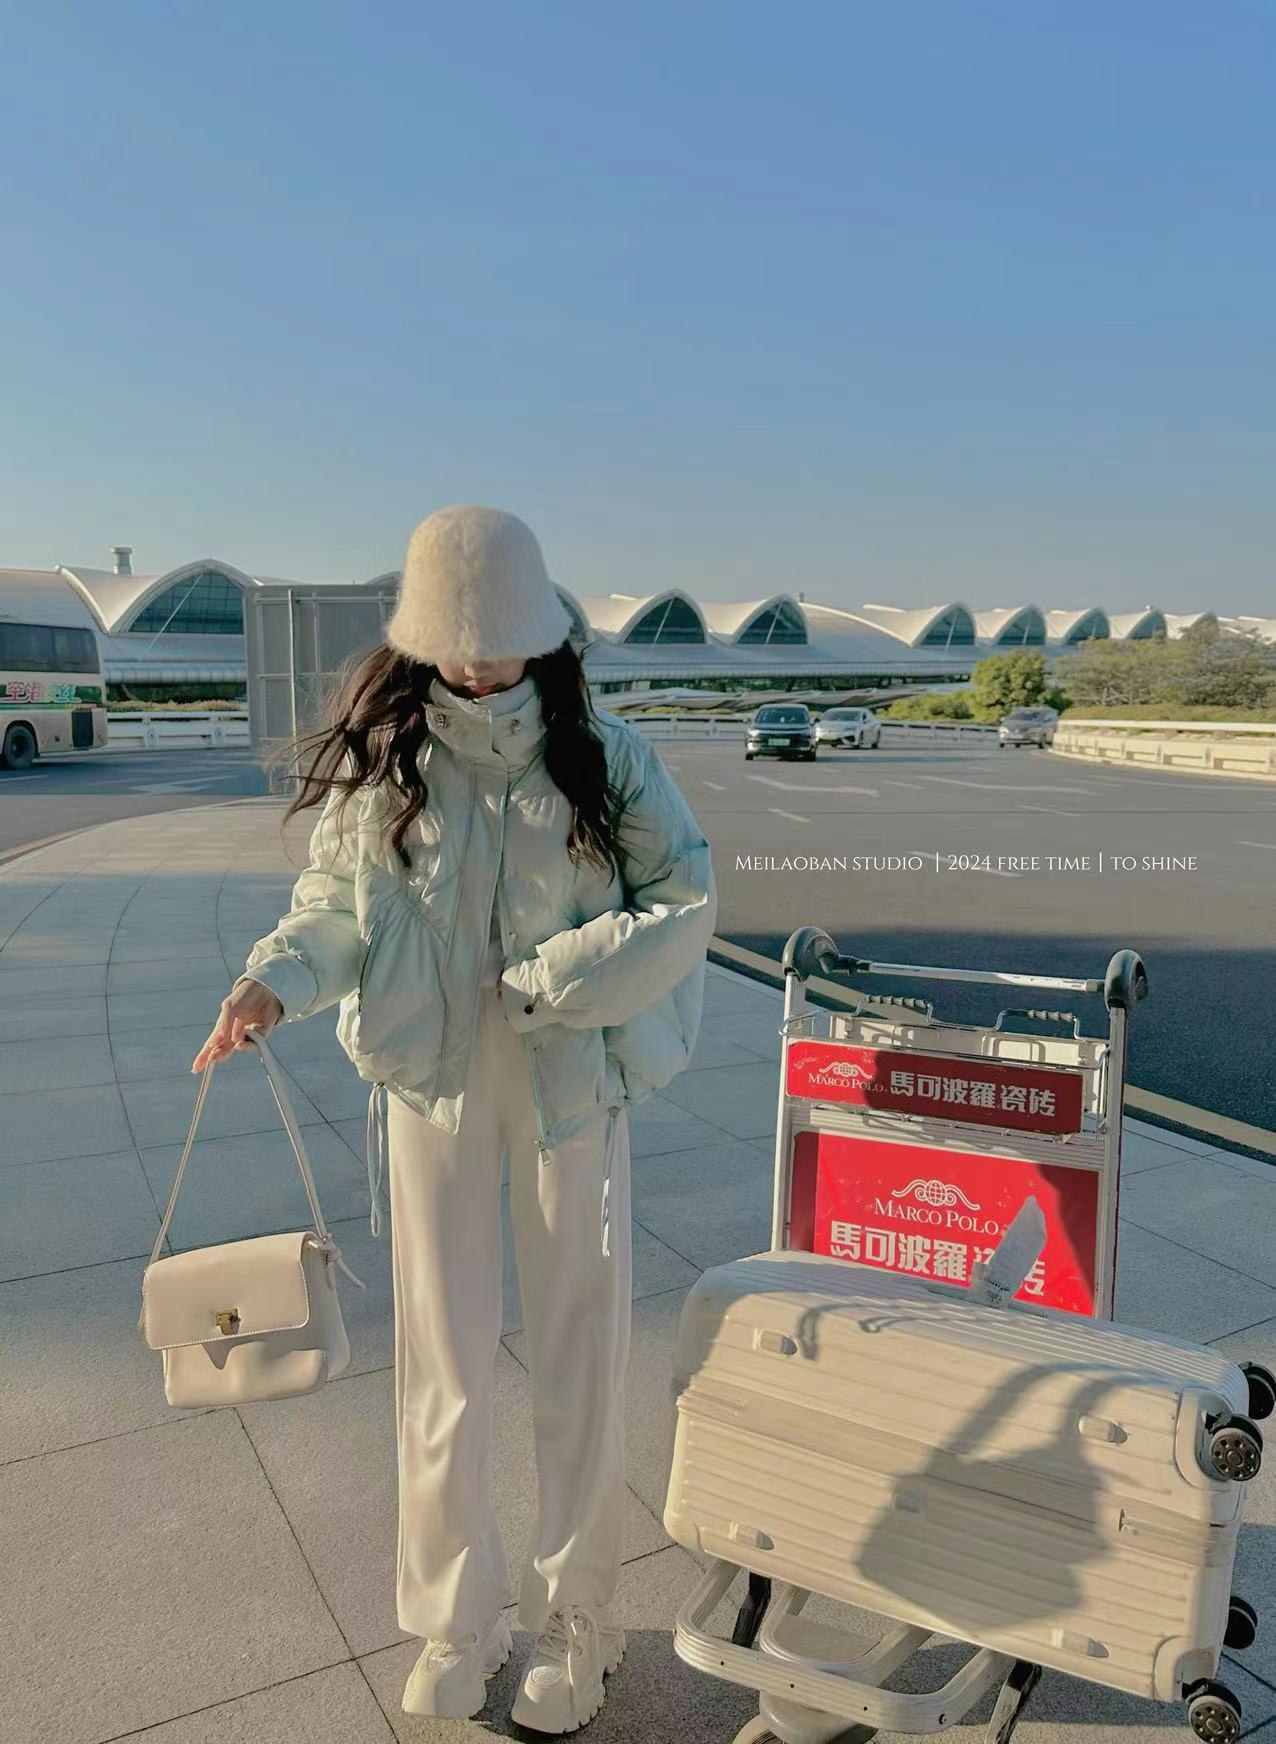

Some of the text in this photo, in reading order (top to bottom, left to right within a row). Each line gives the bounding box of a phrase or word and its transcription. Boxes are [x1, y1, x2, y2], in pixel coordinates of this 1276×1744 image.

[808, 1073, 850, 1089] MARCO
[890, 1070, 1056, 1117] 馬可波羅瓷砖
[874, 1198, 999, 1236] MARCO POLO
